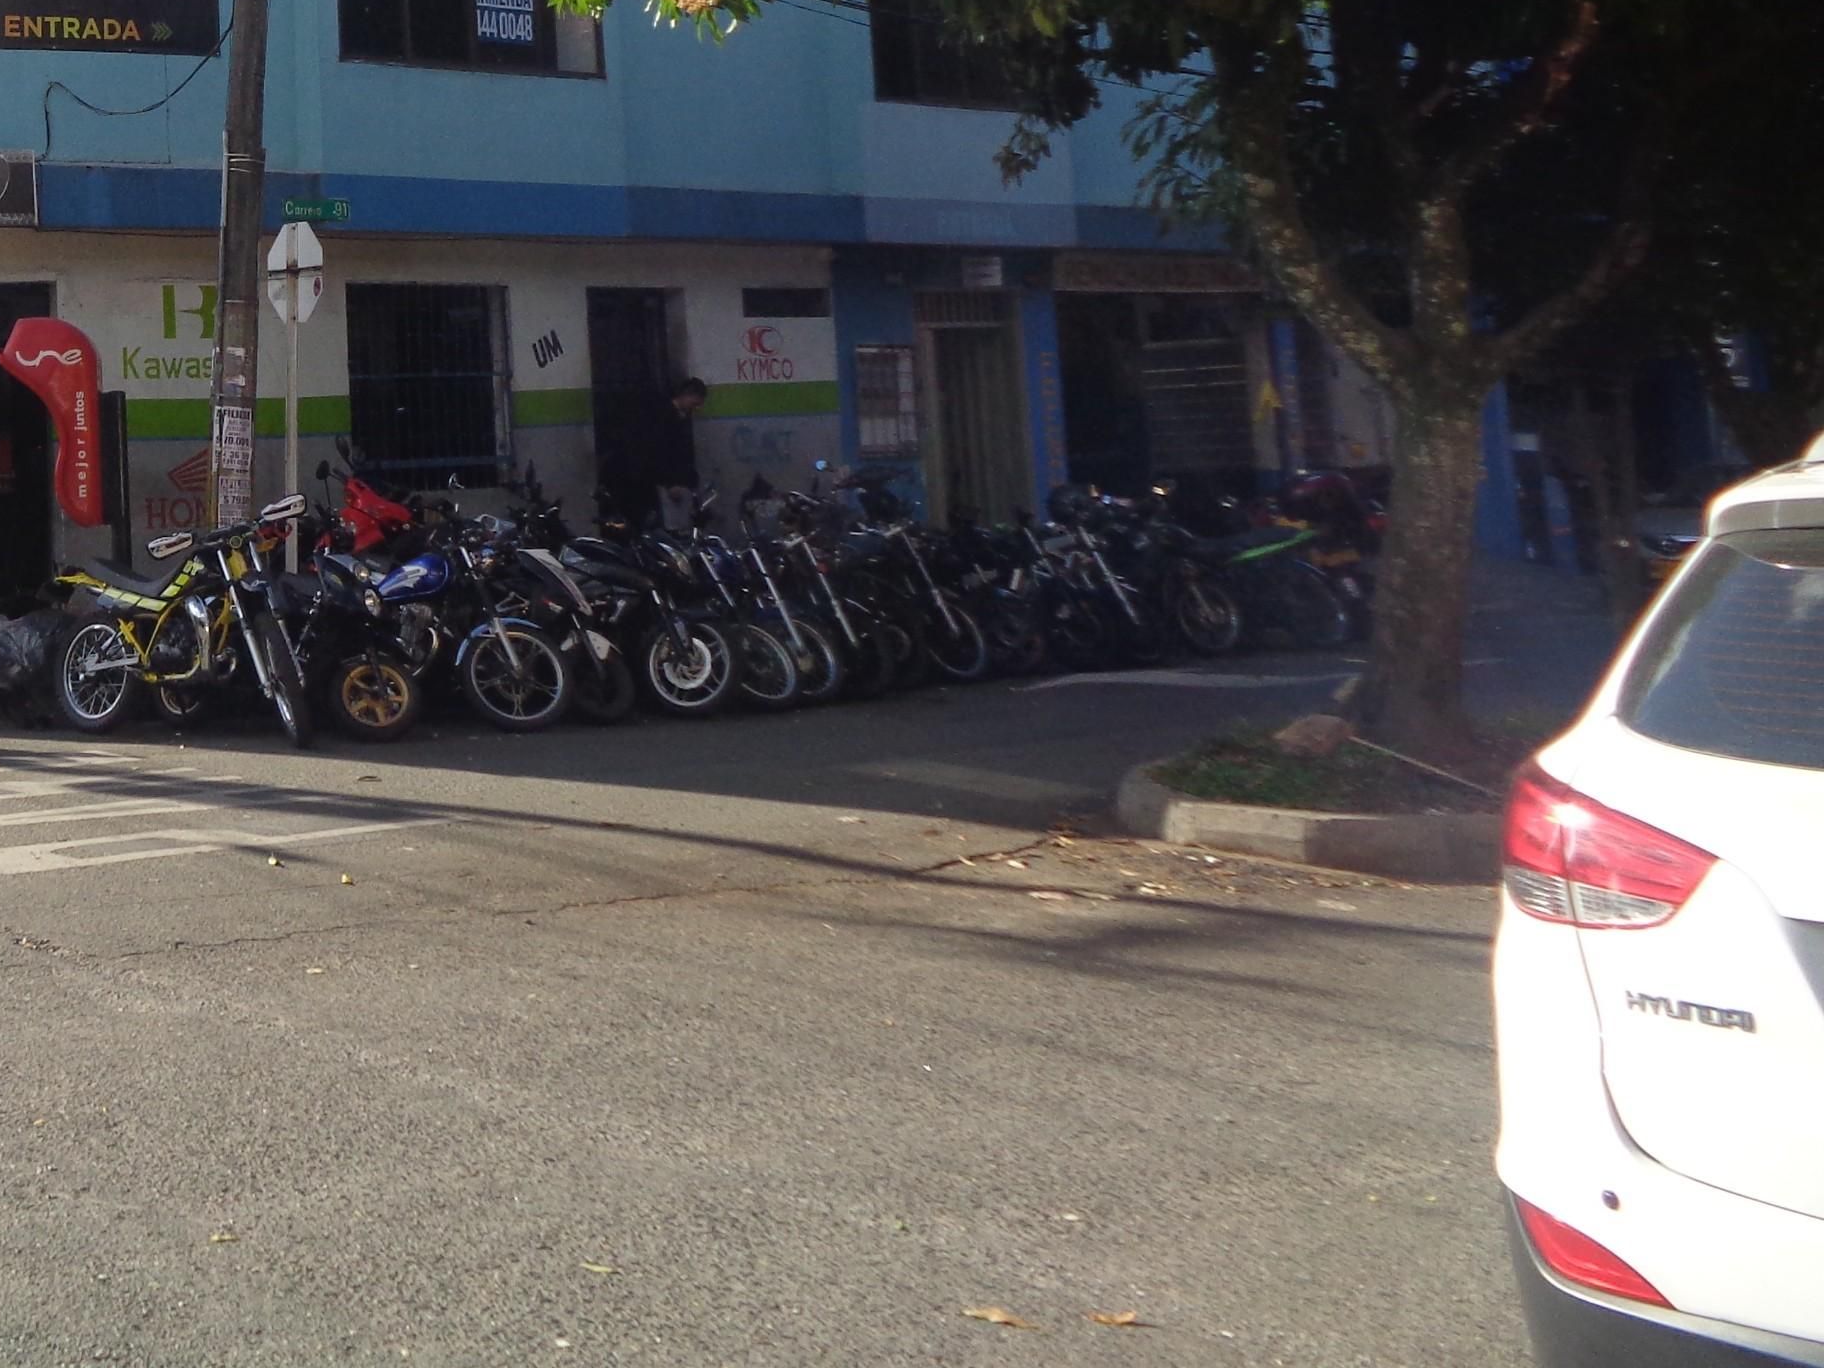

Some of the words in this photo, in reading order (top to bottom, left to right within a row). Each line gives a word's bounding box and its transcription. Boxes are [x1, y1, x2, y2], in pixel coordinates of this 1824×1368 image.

[4, 15, 142, 42] ENTRADA
[499, 12, 533, 41] 0048
[15, 348, 82, 367] une
[532, 329, 564, 369] UM
[737, 358, 793, 381] KYMCO
[74, 391, 87, 431] juntos
[75, 438, 88, 498] mejor
[1625, 990, 1757, 1034] HYUNDAI
